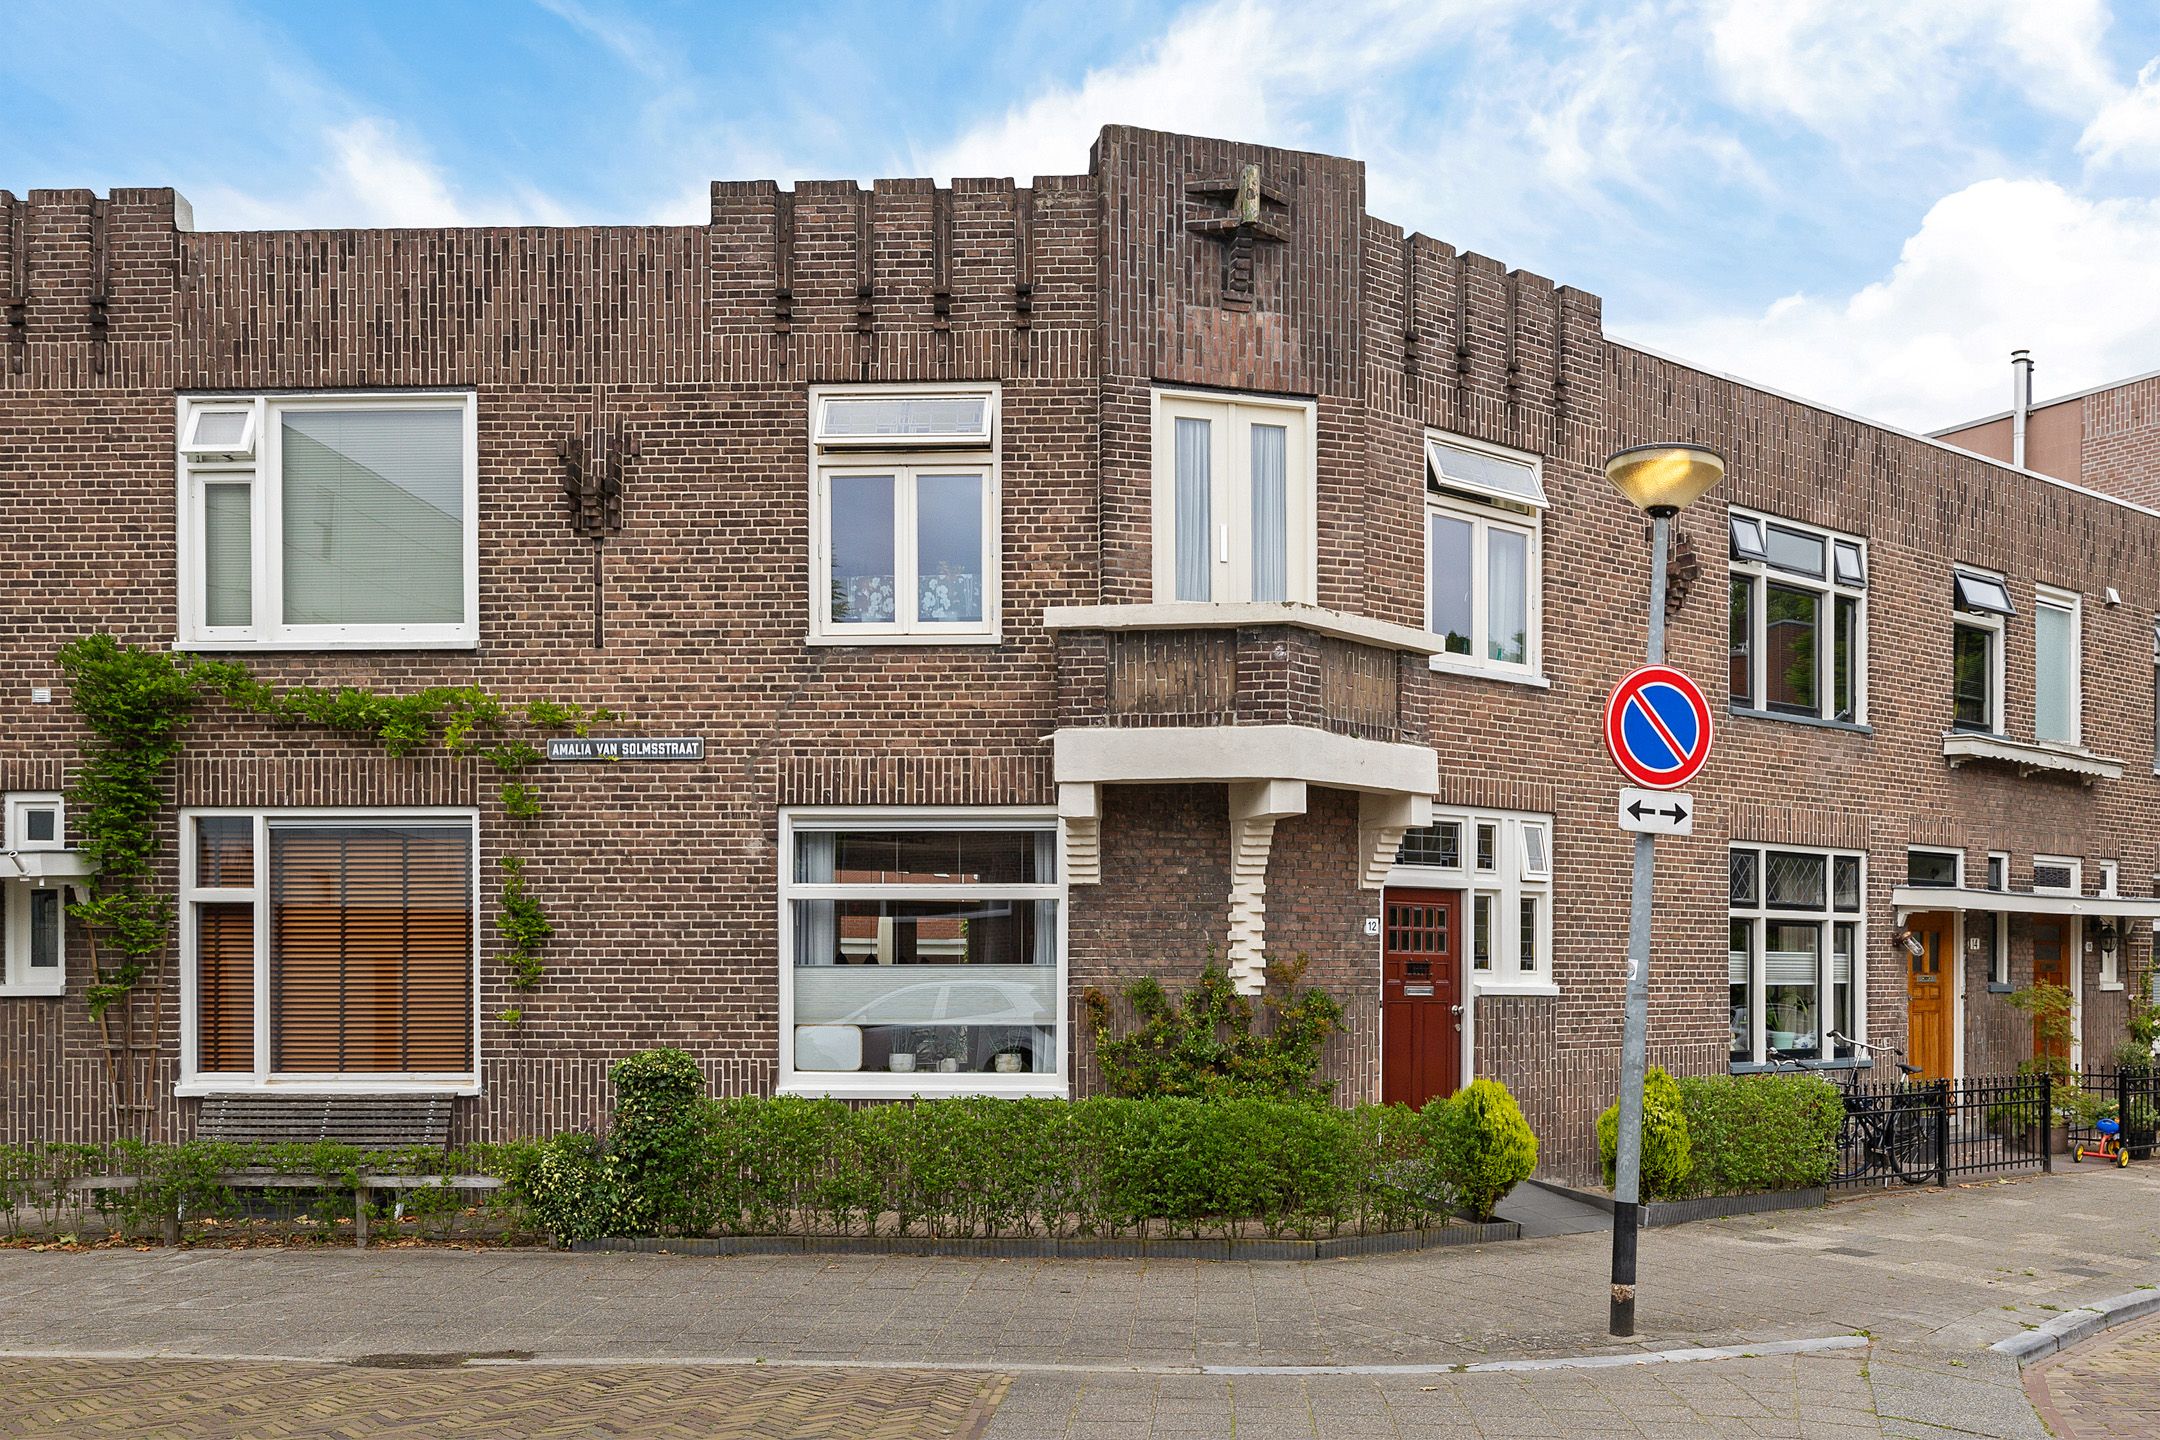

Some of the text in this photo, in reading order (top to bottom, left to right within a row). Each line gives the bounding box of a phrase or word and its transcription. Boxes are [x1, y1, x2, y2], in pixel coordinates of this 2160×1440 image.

[552, 742, 699, 755] AMALIA VAN SOLMSSTRAAT
[1368, 921, 1377, 931] 12
